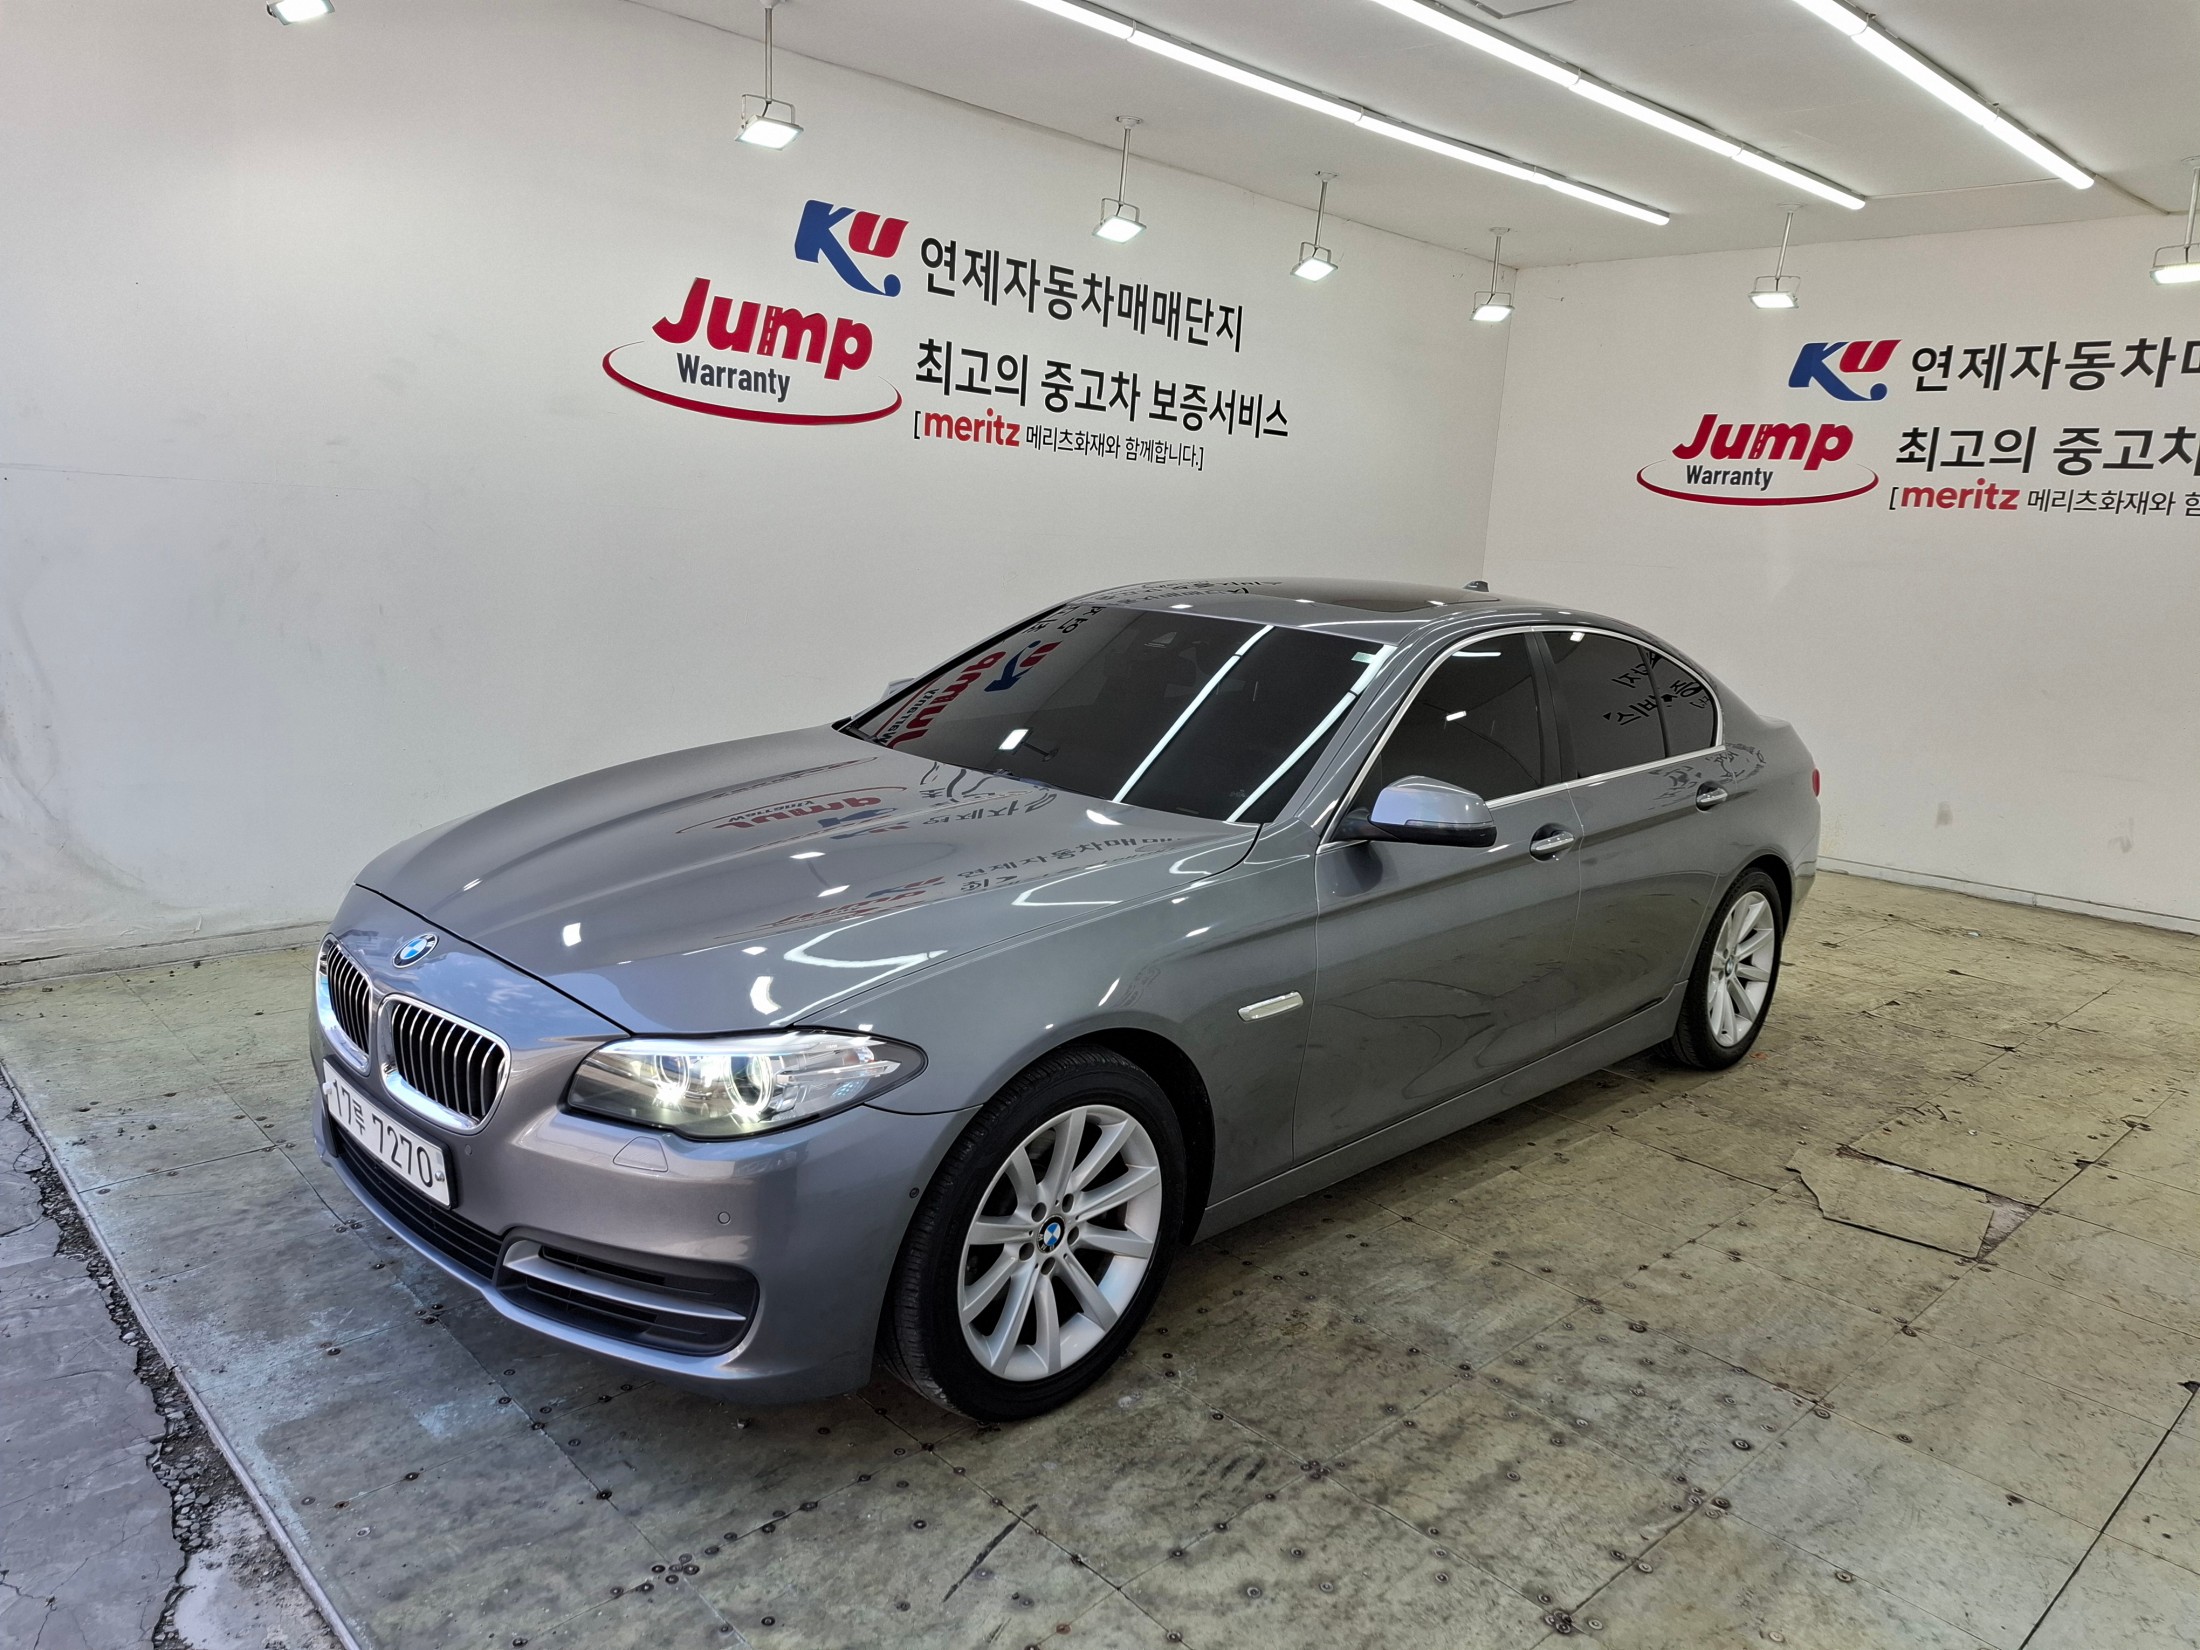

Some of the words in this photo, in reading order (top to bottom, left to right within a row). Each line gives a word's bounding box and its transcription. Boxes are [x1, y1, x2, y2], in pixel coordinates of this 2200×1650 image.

[920, 237, 1243, 353] 연제자동차매매단지
[651, 277, 873, 381] Jump
[676, 352, 791, 403] Warranty
[915, 337, 1029, 408] 최고의
[1040, 360, 1142, 422] 중고차
[1148, 379, 1289, 439] 보증서비스
[1025, 424, 1122, 460] 메리츠화재와
[1125, 436, 1205, 472] 함께합니다.]
[1671, 413, 1854, 471] Jump
[1895, 425, 2037, 473] 최고의
[1685, 464, 1774, 491] Warranty
[2026, 488, 2177, 517] 메리츠화재와
[333, 1079, 366, 1136] 17루
[372, 1113, 433, 1188] 7270
